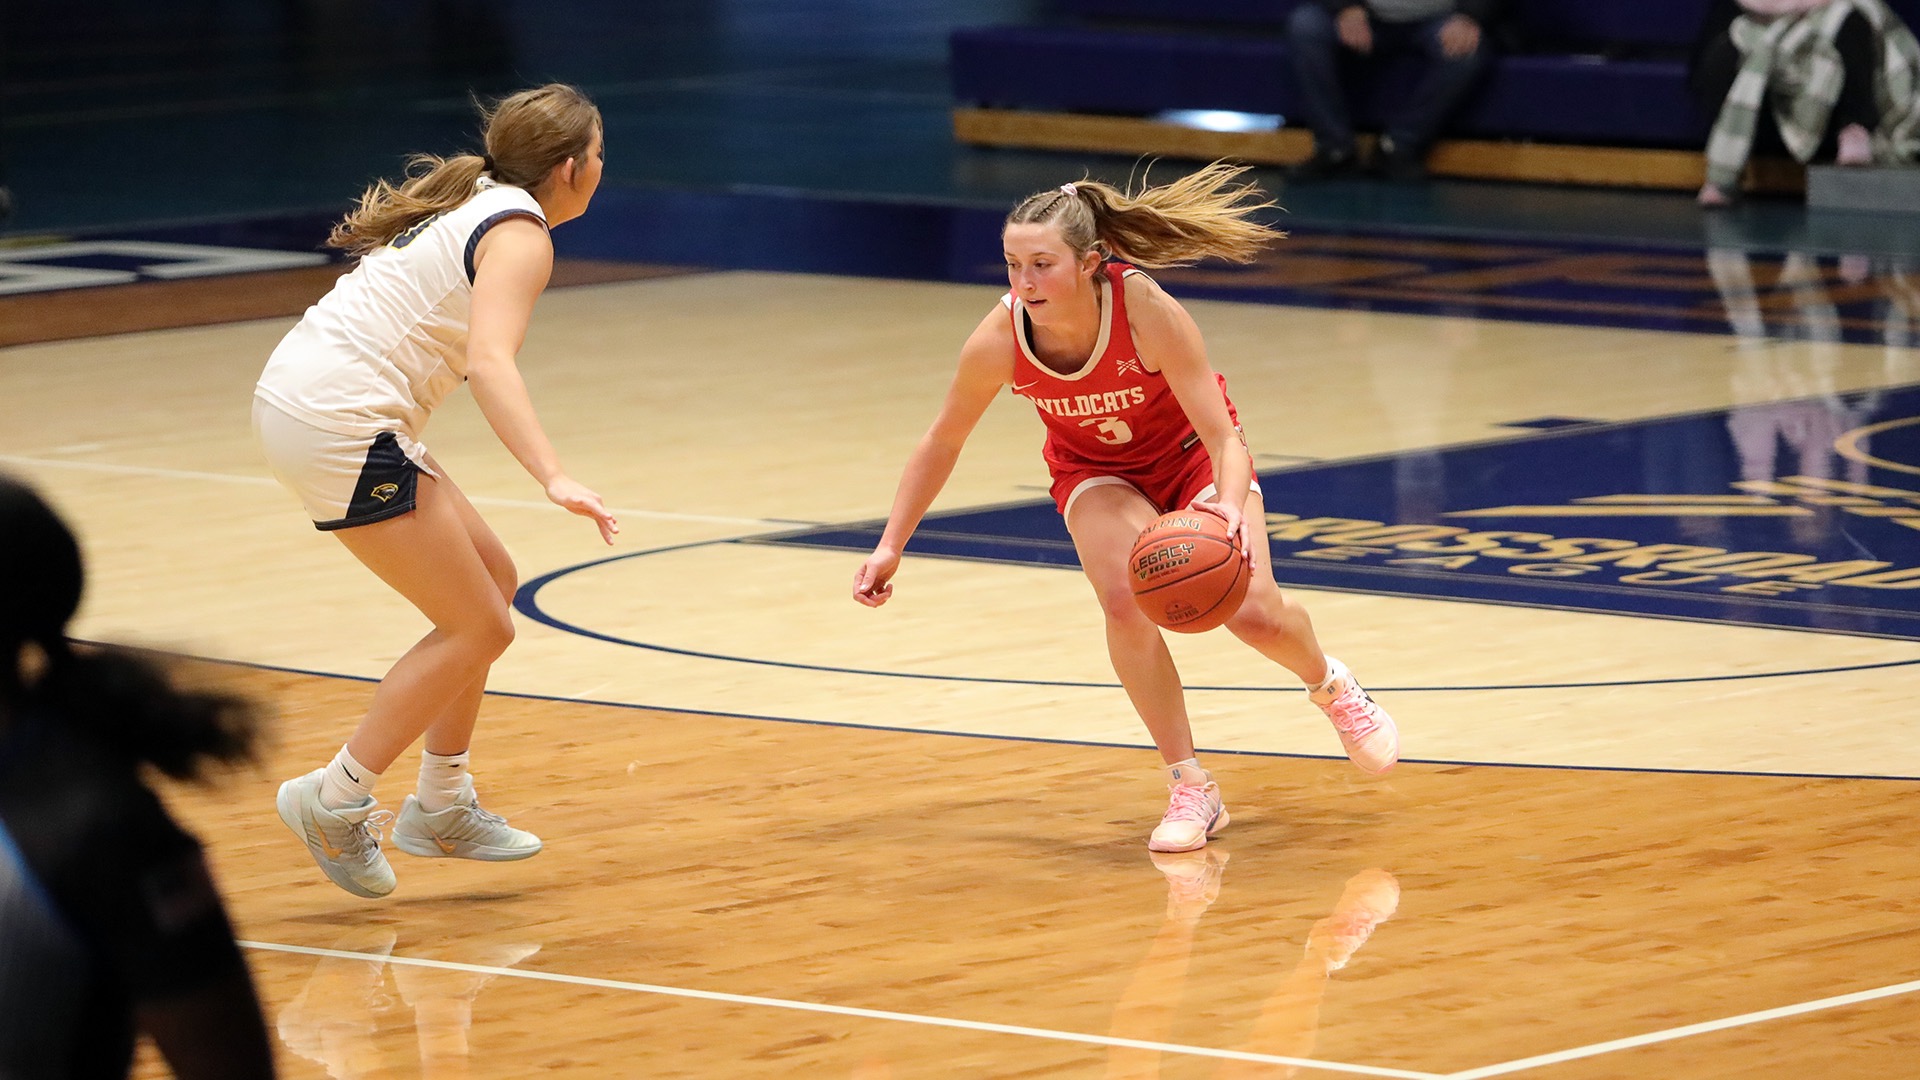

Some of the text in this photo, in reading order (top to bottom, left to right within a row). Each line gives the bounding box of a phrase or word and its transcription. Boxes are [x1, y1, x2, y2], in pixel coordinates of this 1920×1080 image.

[1029, 386, 1145, 416] WILDCATS
[1078, 416, 1133, 445] 3
[1132, 542, 1195, 574] LEGACY
[1264, 512, 1920, 589] ROSSROA
[1293, 545, 1824, 596] EAGUE
